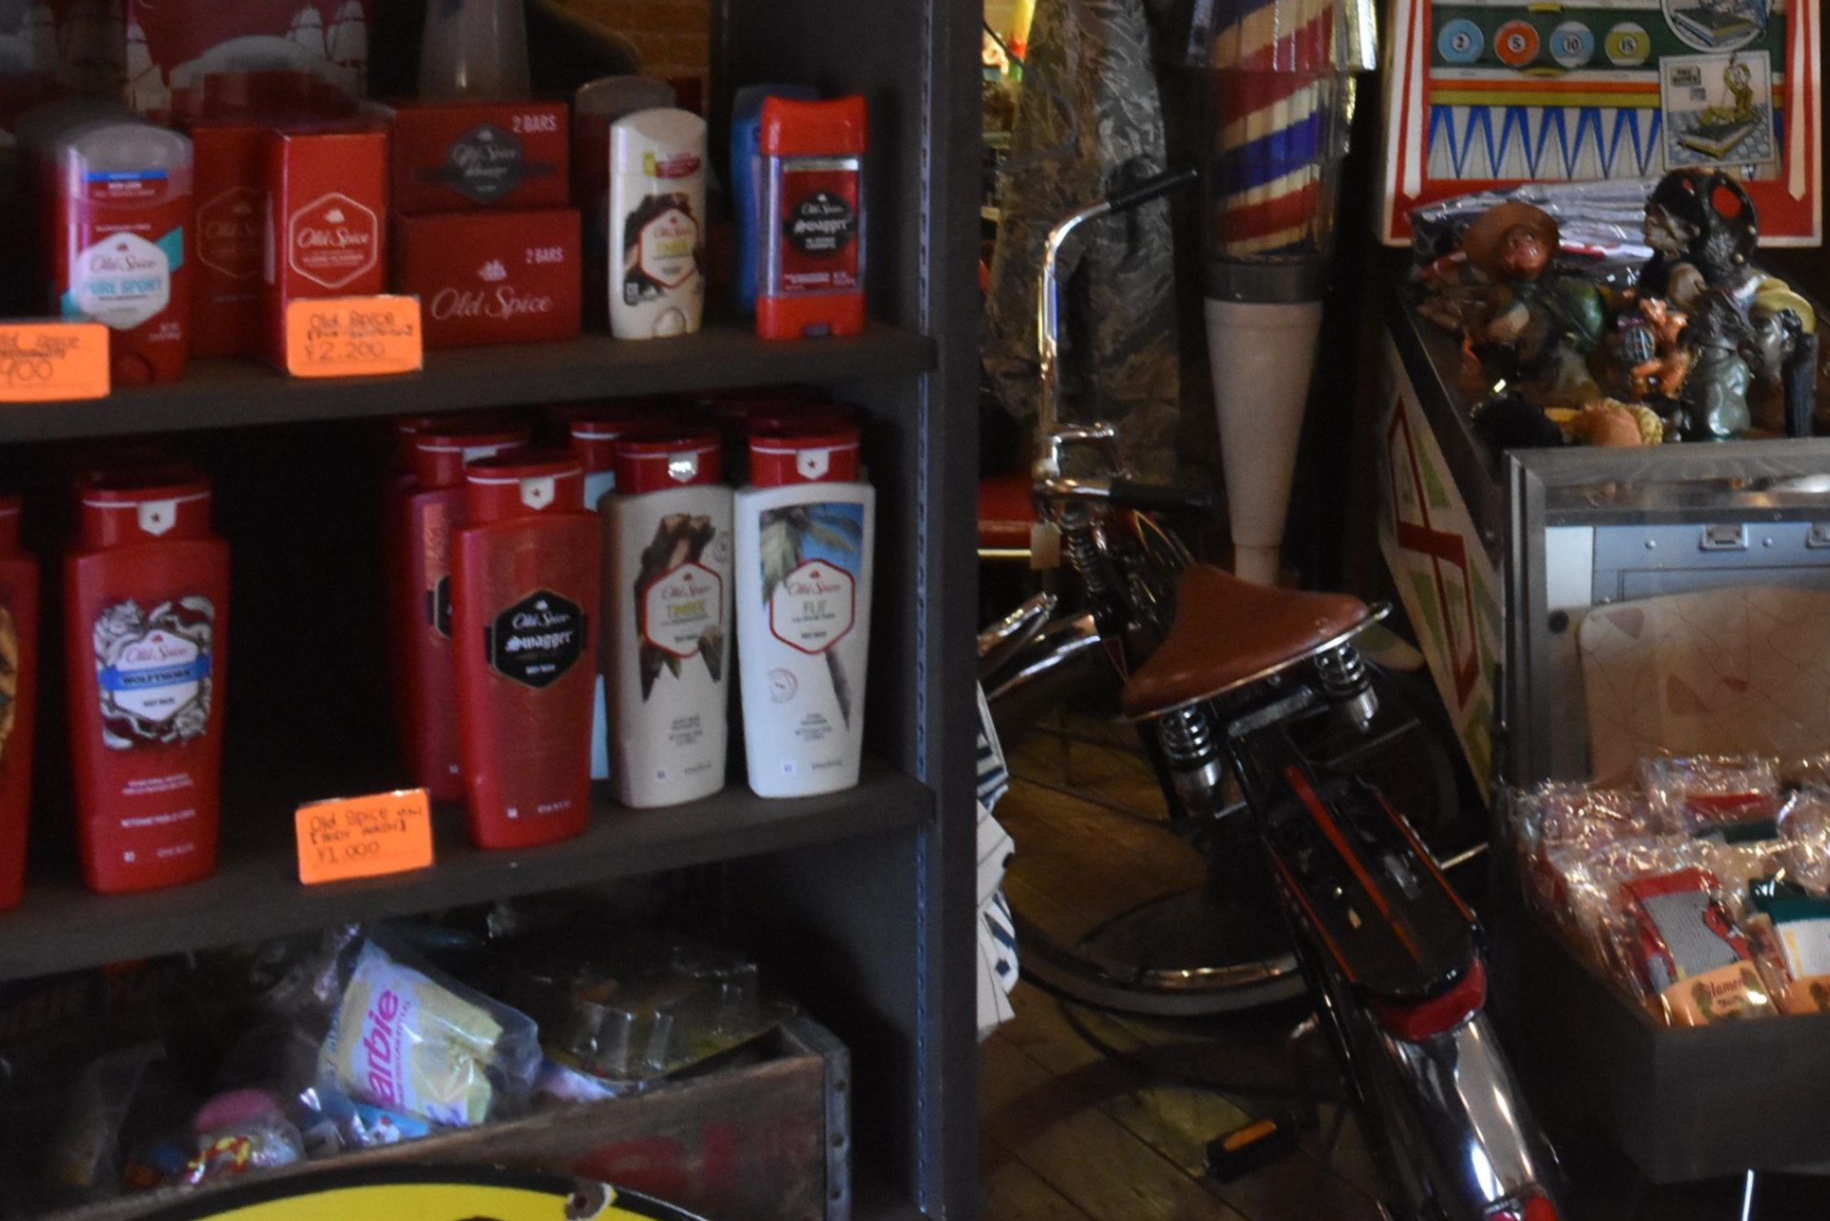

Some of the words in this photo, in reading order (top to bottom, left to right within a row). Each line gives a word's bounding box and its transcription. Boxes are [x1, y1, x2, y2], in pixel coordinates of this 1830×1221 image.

[1455, 35, 1467, 50] 2
[1511, 36, 1523, 51] 5
[1564, 37, 1581, 52] 10
[512, 115, 523, 133] 2
[431, 286, 485, 321] Old
[484, 285, 554, 320] Spice
[504, 629, 575, 652] Swagger
[366, 988, 400, 1109] arbie
